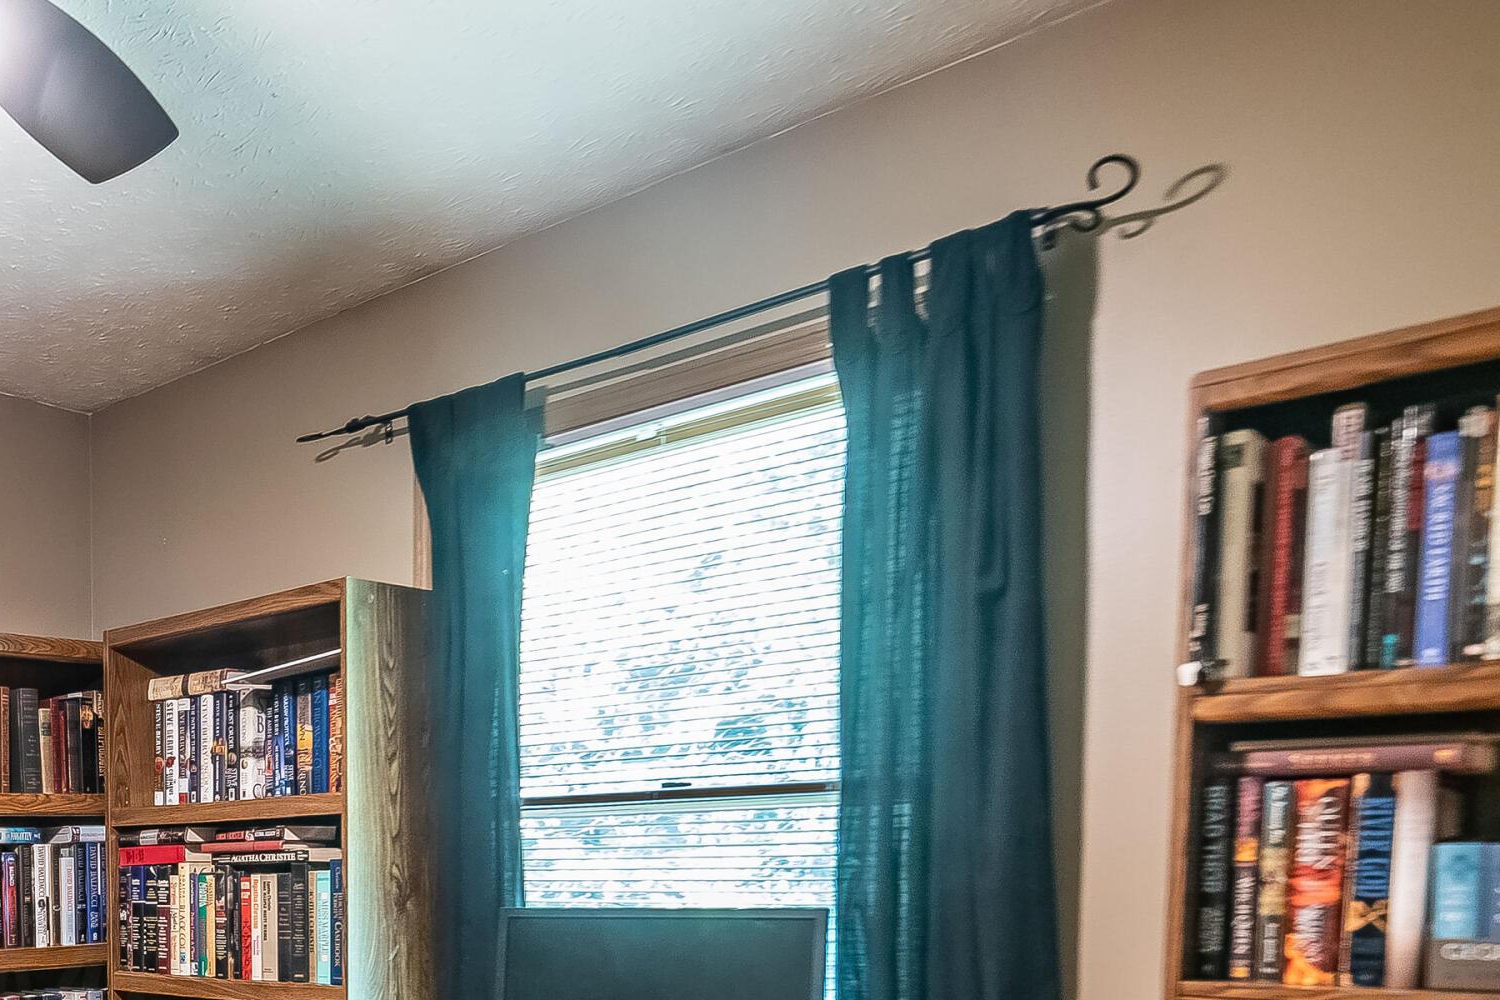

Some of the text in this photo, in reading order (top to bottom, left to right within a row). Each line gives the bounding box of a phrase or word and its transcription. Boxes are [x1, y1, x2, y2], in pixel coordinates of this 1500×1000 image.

[166, 702, 174, 755] STEVE BERRY
[90, 846, 99, 907] DAVID BALDACCI
[231, 852, 296, 862] AGATHA CHRISTIE
[334, 921, 343, 967] CASEBOOK
